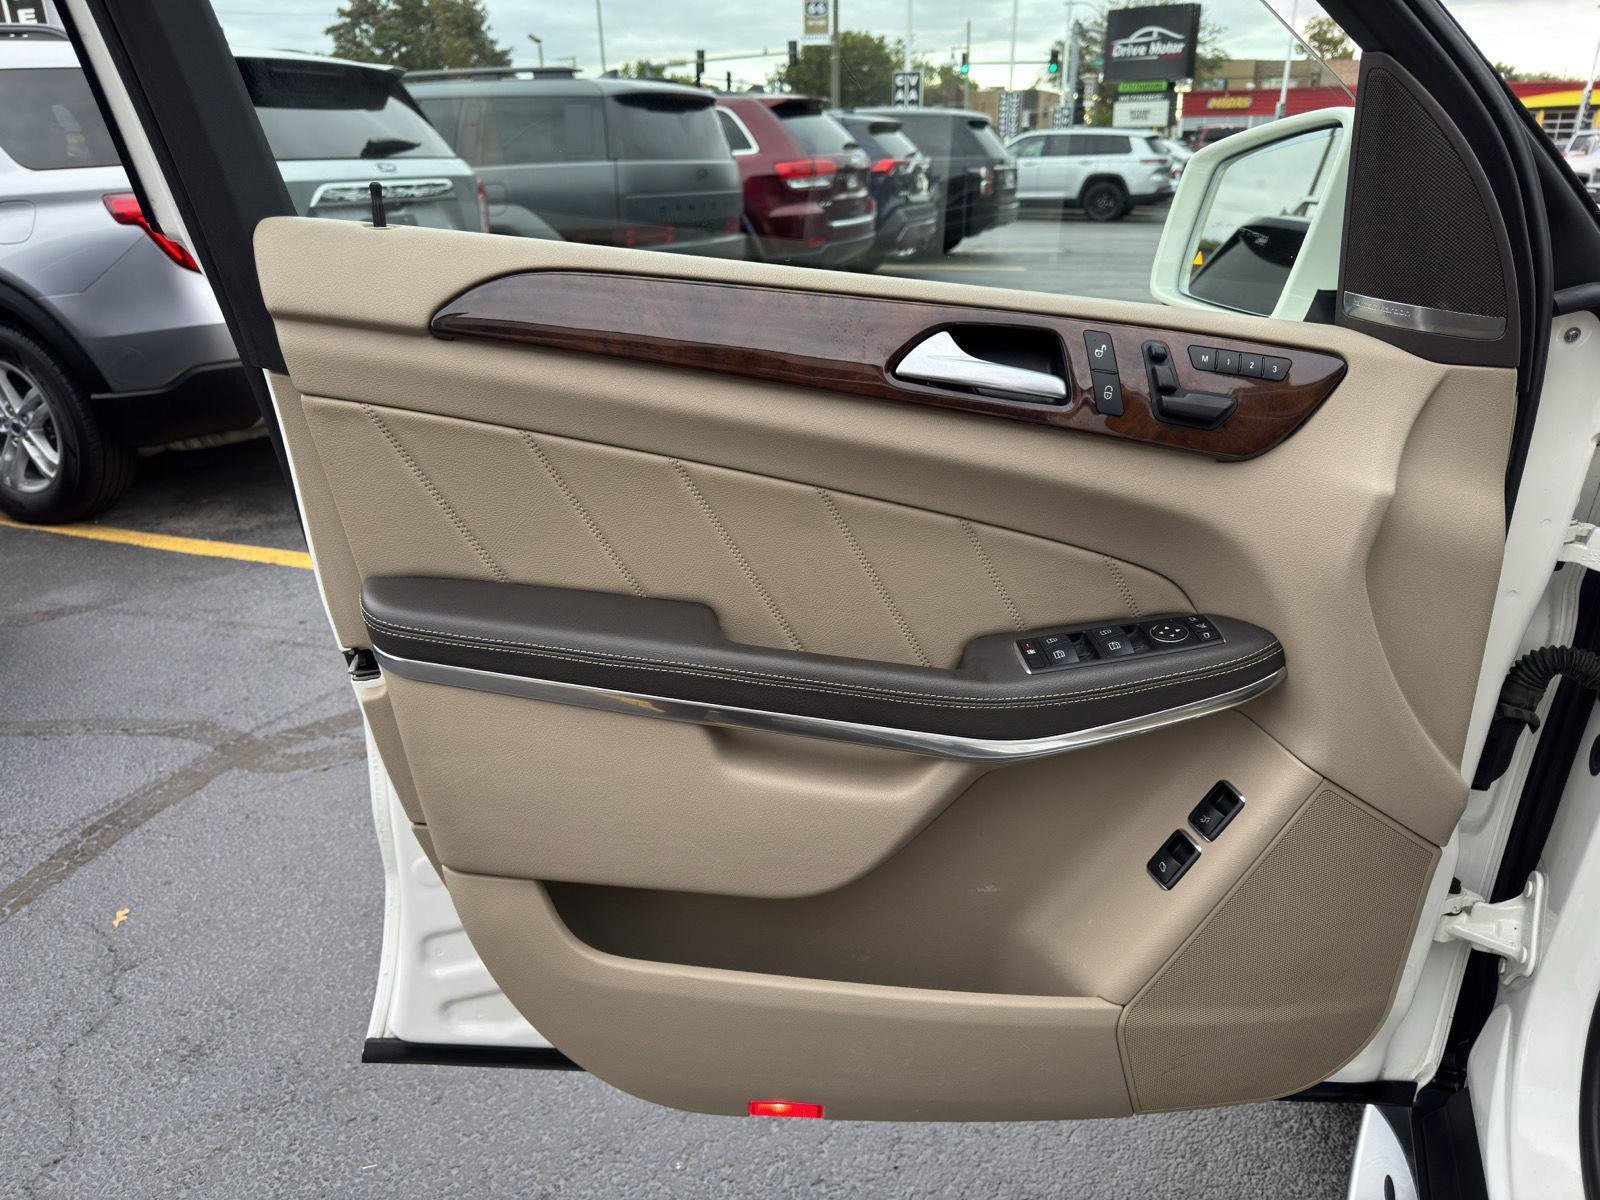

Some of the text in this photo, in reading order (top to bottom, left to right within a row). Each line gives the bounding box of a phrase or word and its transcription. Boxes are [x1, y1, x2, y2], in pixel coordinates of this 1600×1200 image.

[1112, 41, 1186, 58] Drive Motor
[1201, 355, 1278, 373] M 1 2 3
